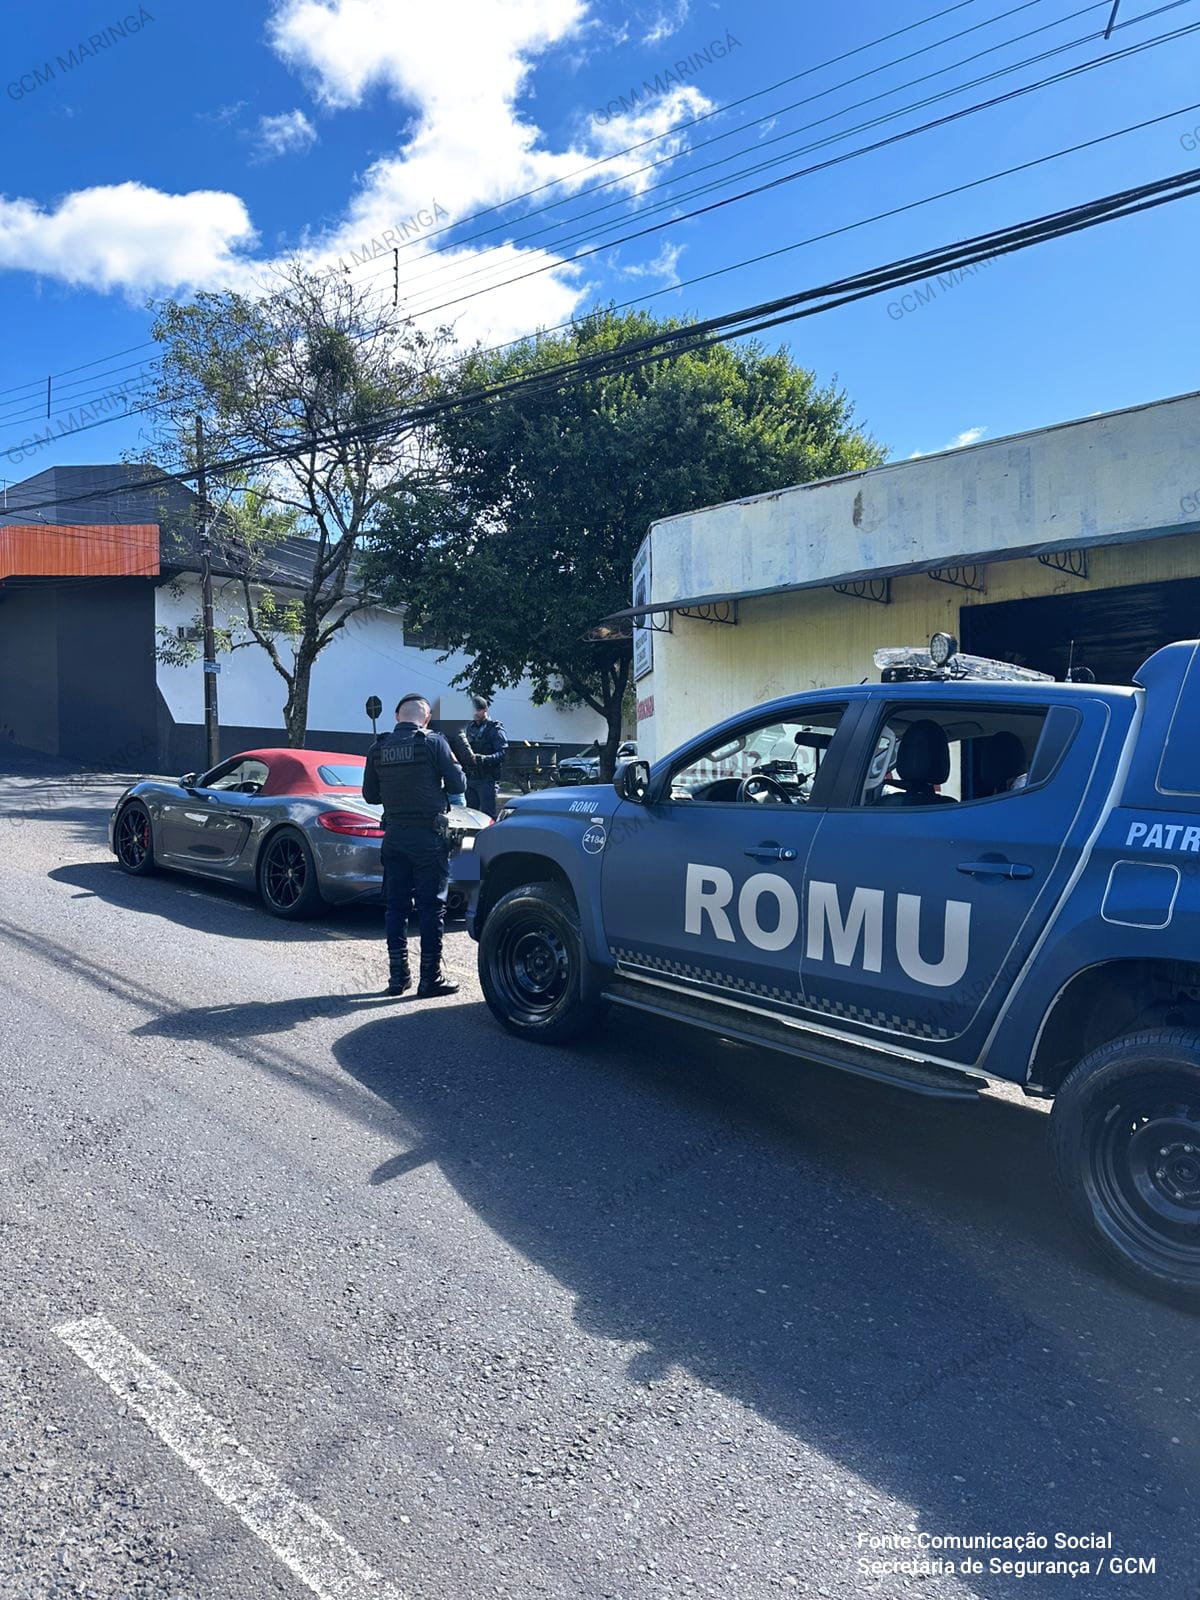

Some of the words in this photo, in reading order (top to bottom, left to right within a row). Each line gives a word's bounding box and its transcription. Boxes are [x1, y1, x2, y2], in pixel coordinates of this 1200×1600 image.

[382, 746, 413, 762] ROMU
[568, 800, 599, 813] ROMU
[584, 833, 605, 845] 2184
[1125, 822, 1200, 852] PATR
[684, 862, 972, 988] ROMU
